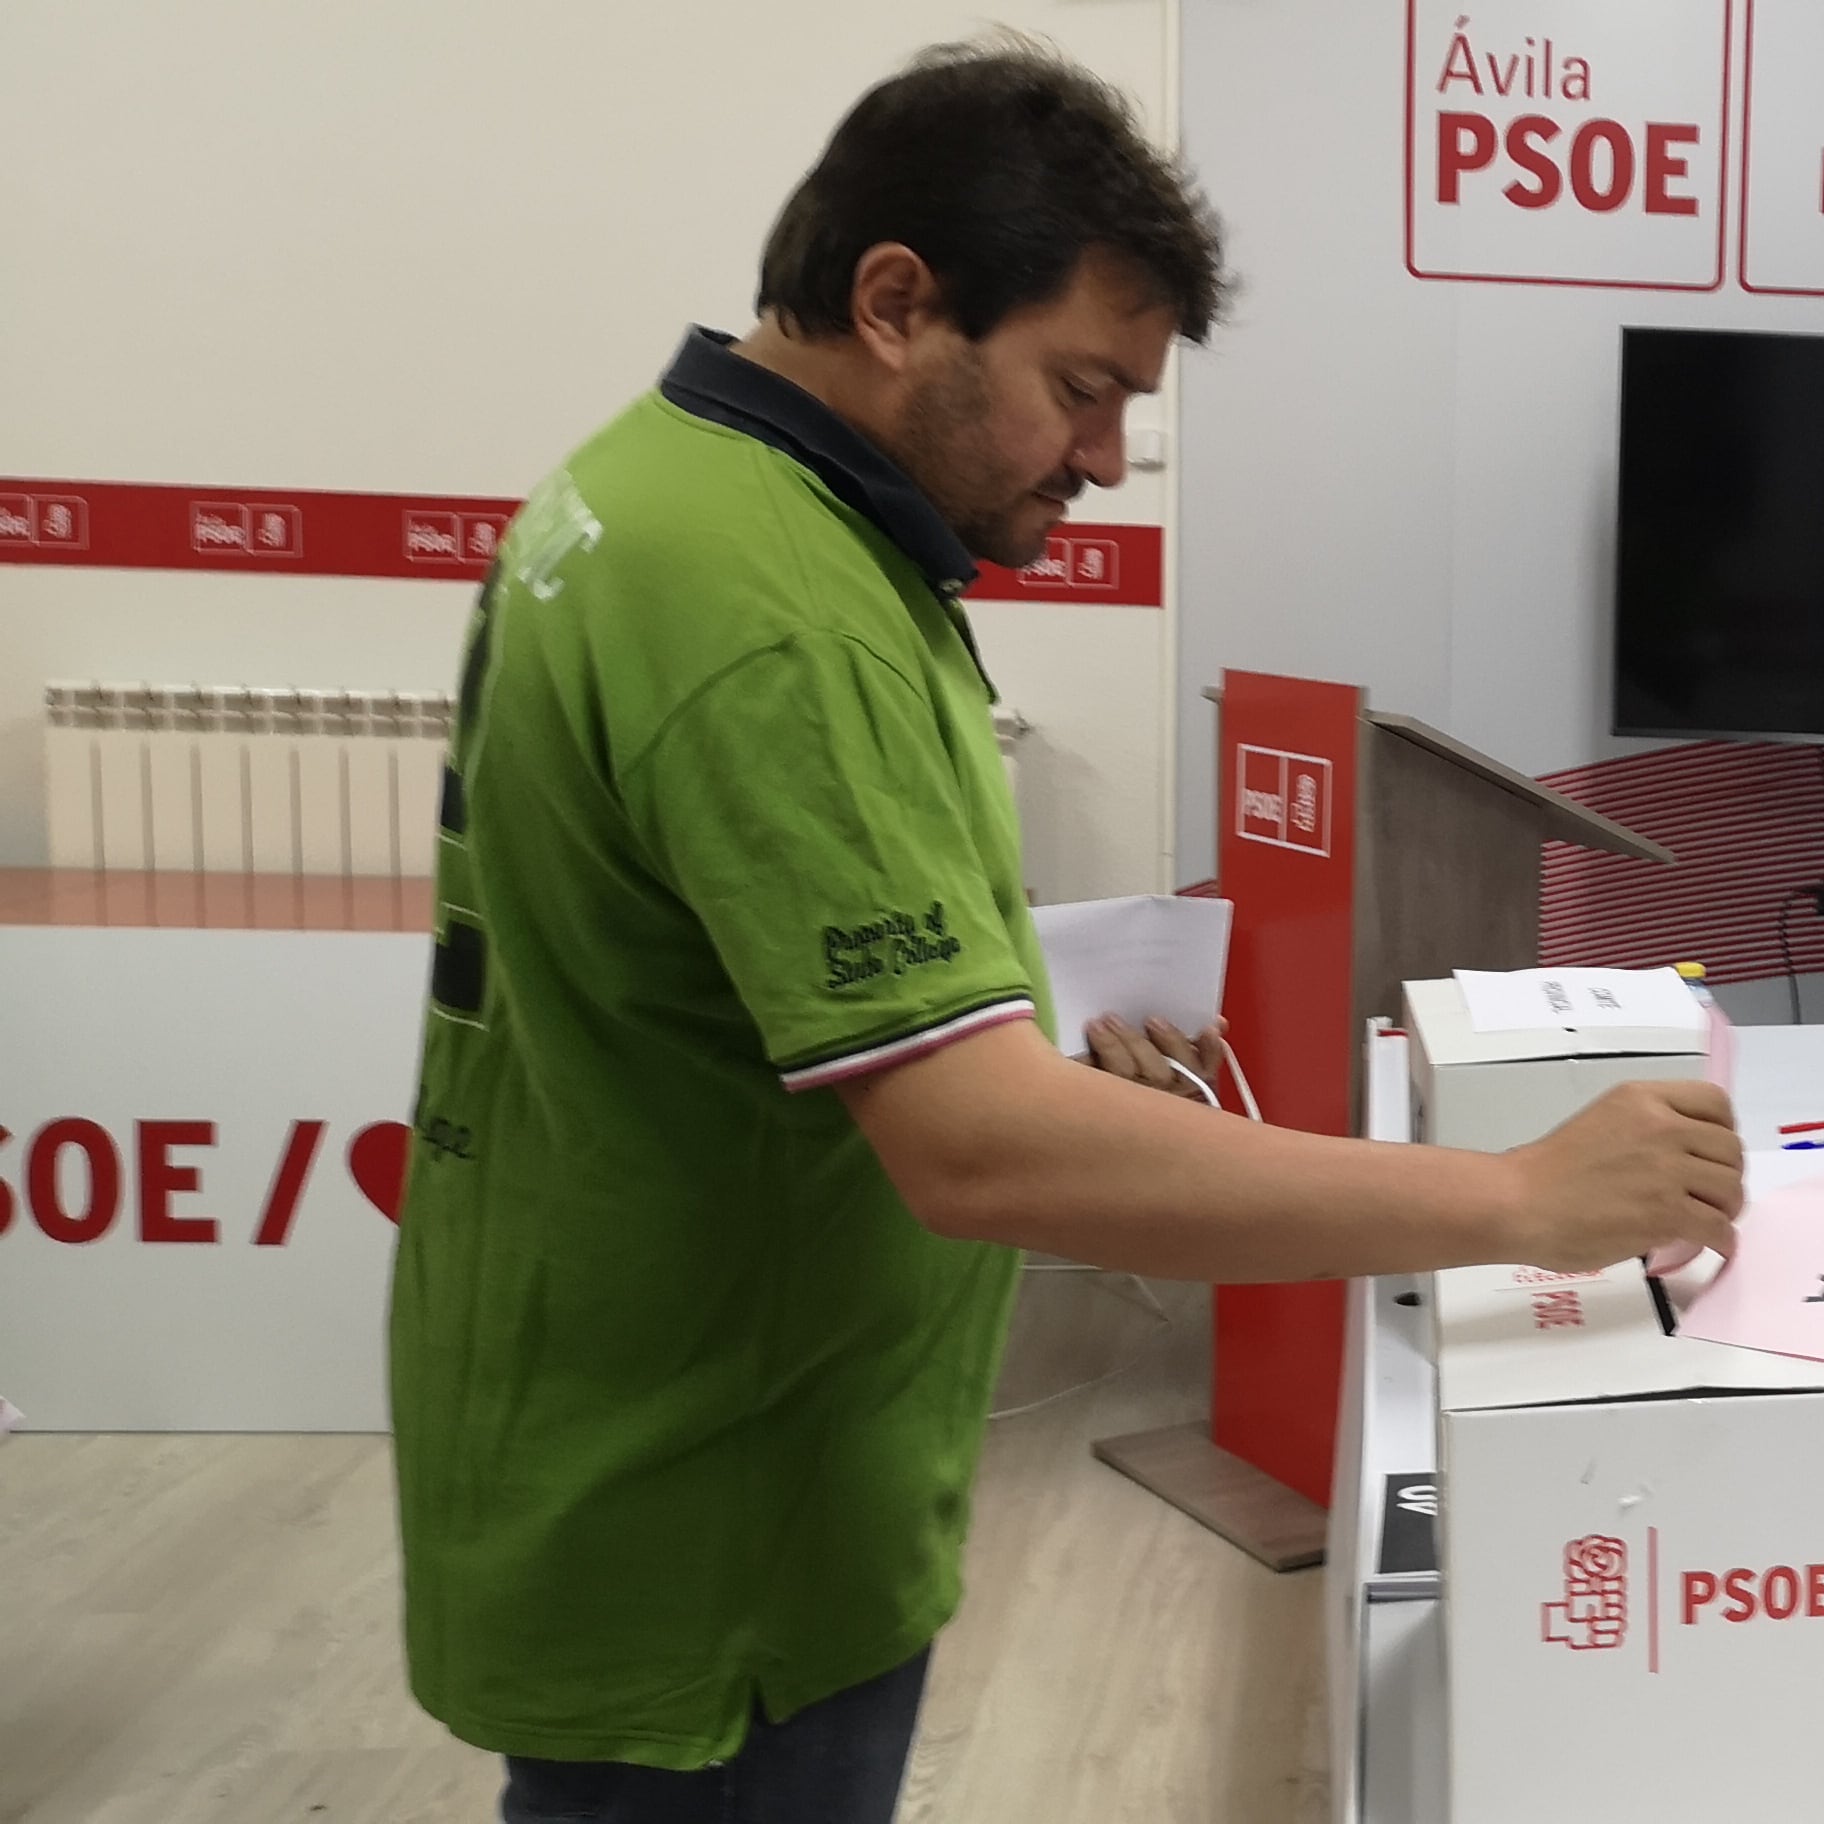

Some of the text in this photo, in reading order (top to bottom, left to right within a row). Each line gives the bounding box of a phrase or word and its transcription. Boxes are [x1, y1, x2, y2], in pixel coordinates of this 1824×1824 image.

[1435, 14, 1593, 102] Ávila
[1436, 110, 1700, 216] PSOE
[0, 1116, 219, 1244] OE
